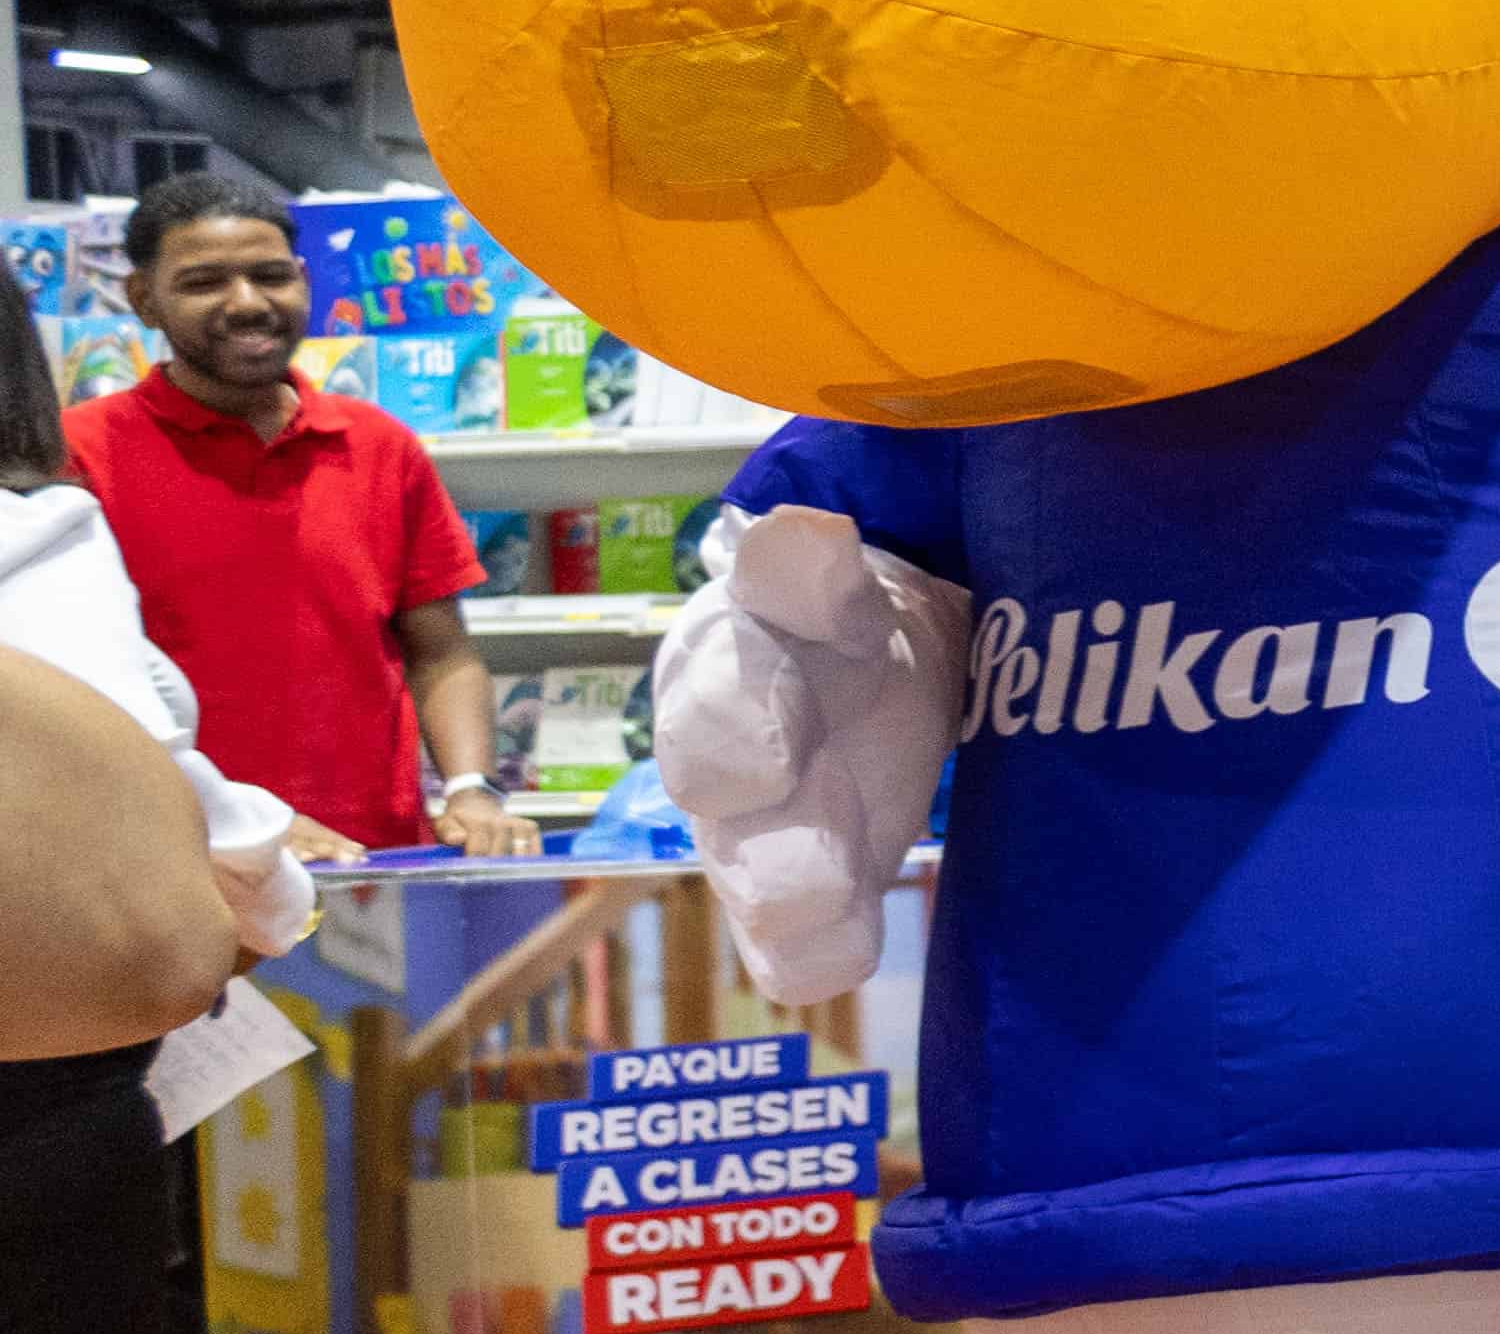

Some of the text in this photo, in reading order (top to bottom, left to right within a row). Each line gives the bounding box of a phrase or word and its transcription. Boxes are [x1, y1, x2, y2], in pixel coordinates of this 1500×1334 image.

[960, 596, 1433, 744] Pelikan
[561, 1082, 870, 1155] REGRESEN
[581, 1141, 860, 1210] A CLASES
[603, 1201, 840, 1257] CON TODO
[607, 1251, 846, 1326] READY
